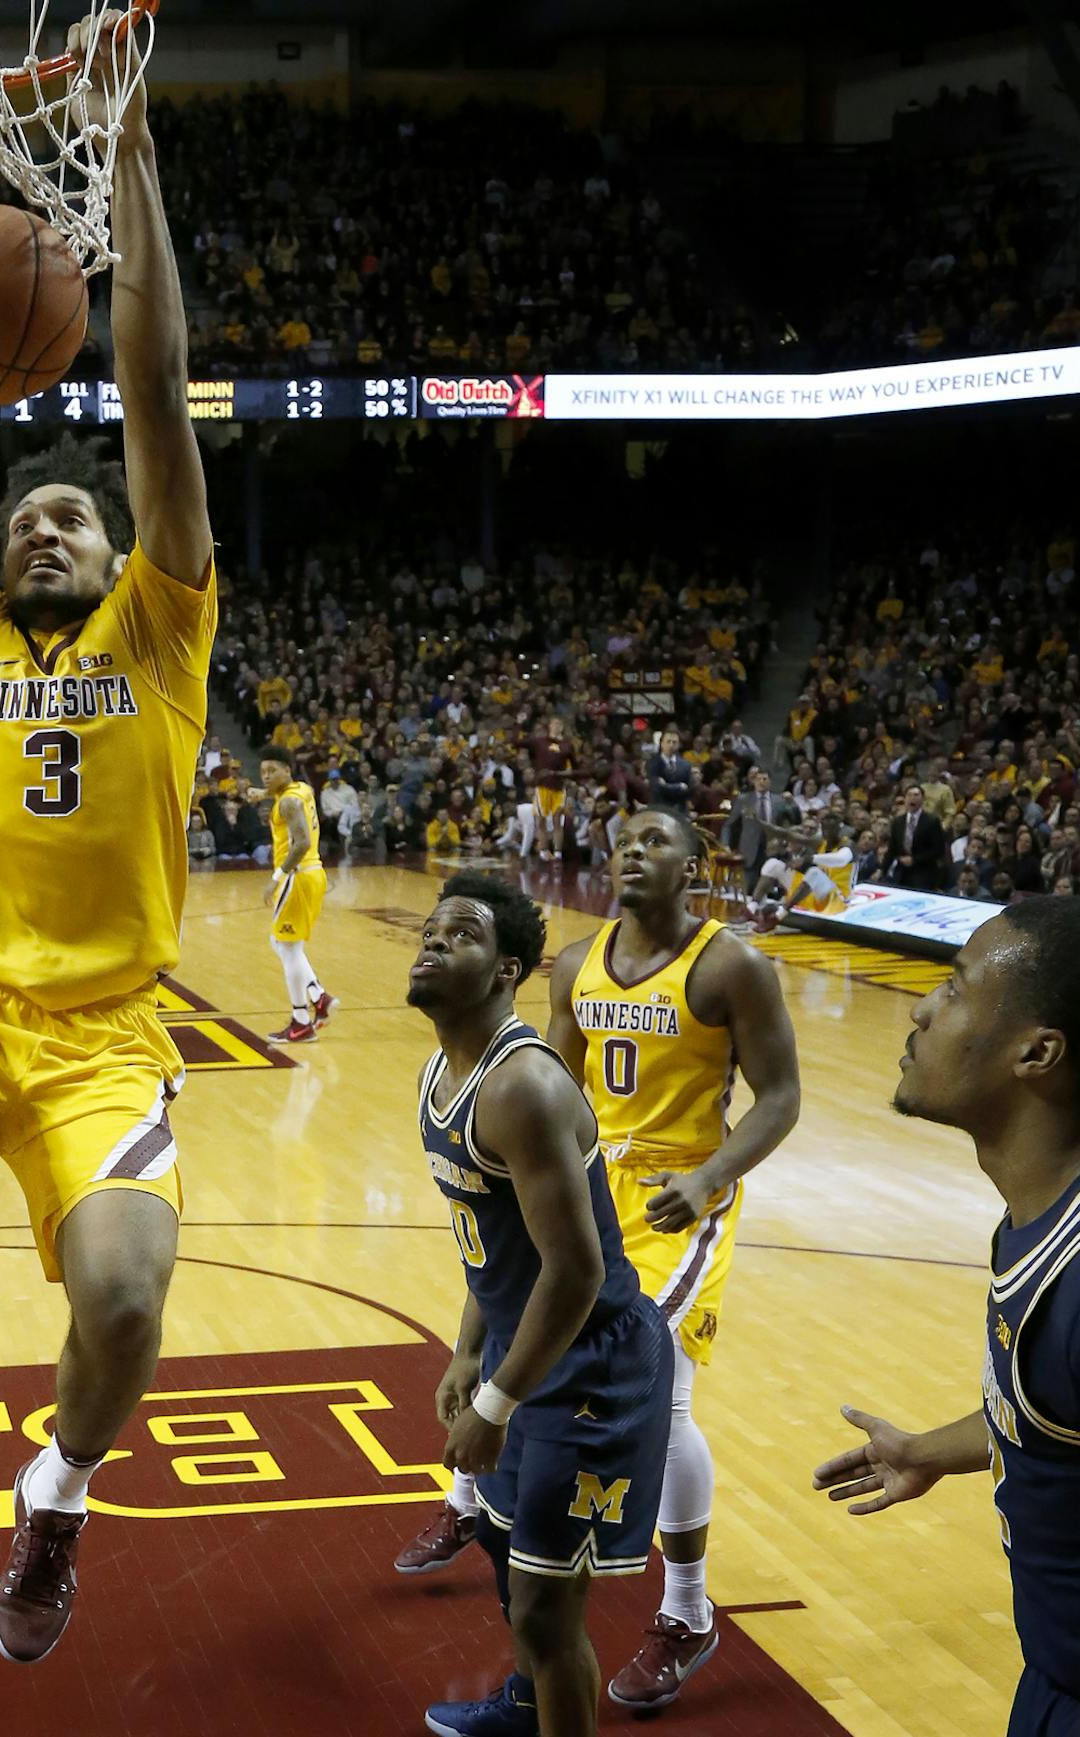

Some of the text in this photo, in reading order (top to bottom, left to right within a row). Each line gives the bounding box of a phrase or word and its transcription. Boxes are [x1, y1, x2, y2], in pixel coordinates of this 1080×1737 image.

[187, 381, 235, 399] MINN
[424, 380, 511, 403] Old Dutch
[571, 364, 1065, 405] XFINITY X1 WILL CHANGE THE WAY YOU EXPERIENCE TV
[64, 398, 83, 421] 4
[188, 401, 234, 419] MICH
[23, 727, 81, 817] 3
[574, 1000, 681, 1037] MINNESOTA
[603, 1036, 638, 1098] 0
[568, 1470, 633, 1524] M
